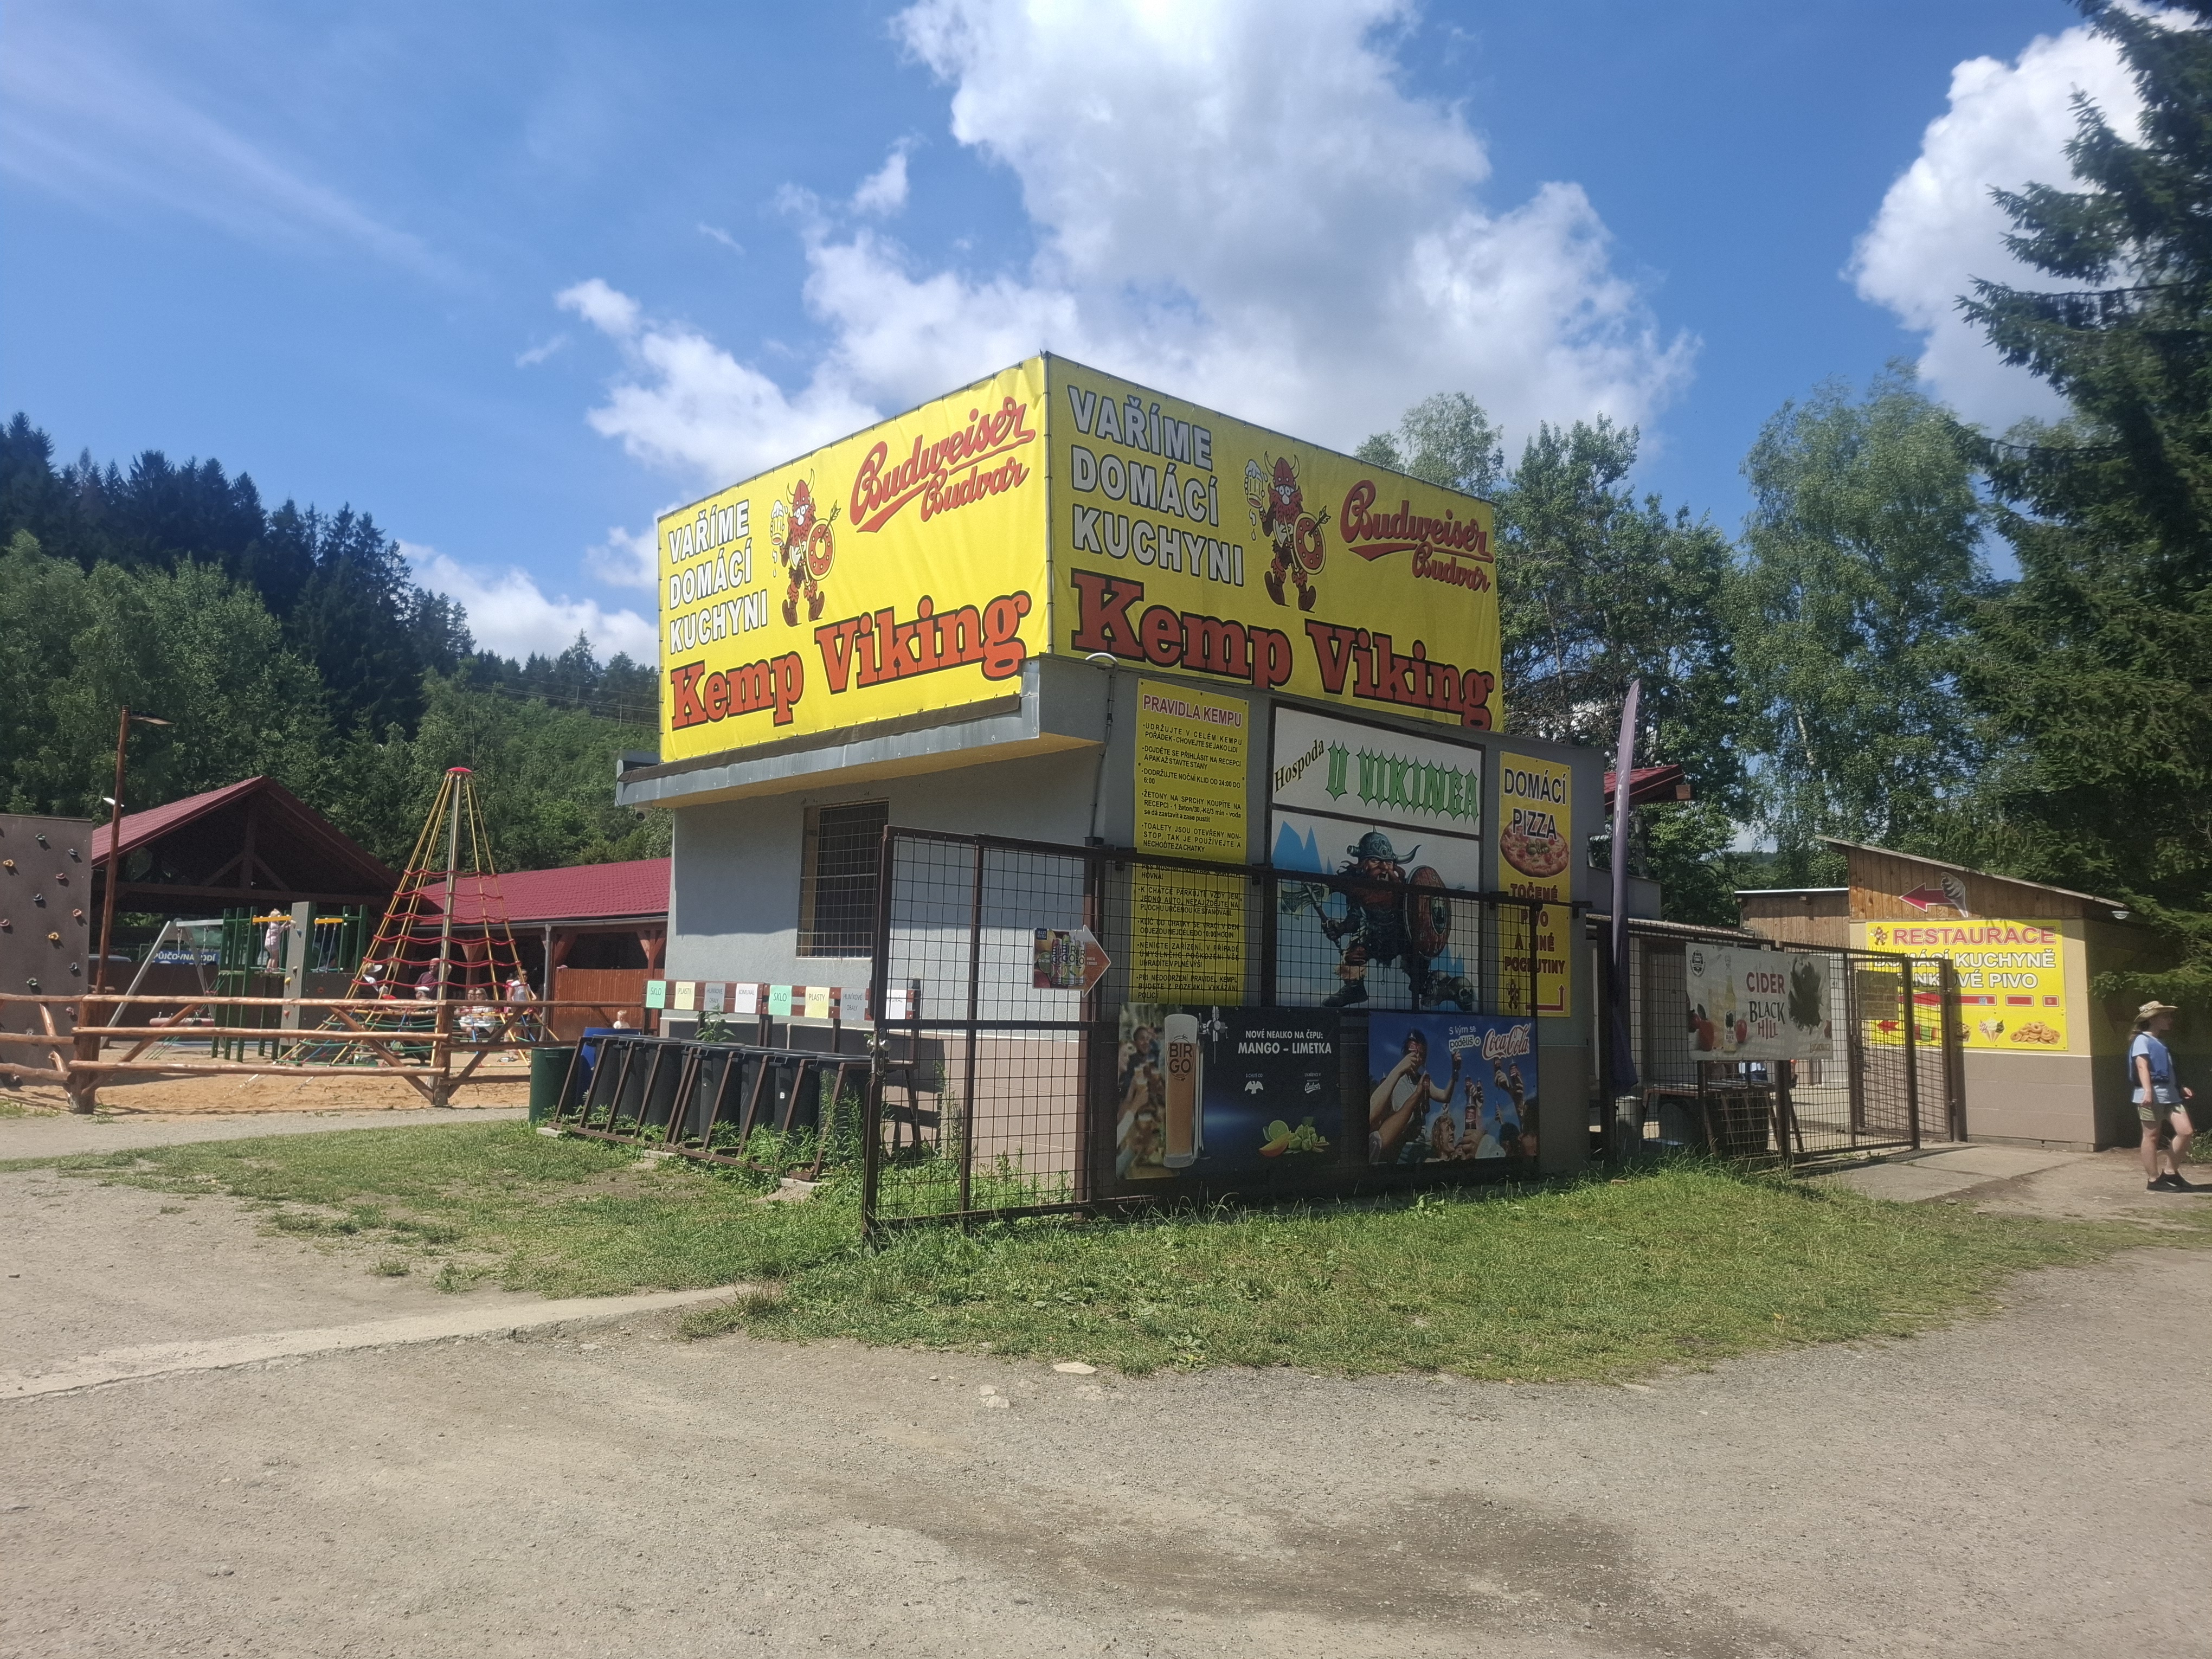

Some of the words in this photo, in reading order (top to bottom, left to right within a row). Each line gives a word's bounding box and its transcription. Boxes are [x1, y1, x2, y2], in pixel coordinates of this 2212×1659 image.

[1067, 385, 1212, 471] VAŘÍME
[850, 396, 1036, 526] Budweiser
[921, 456, 1030, 522] Budvar
[1071, 444, 1218, 526] DOMÁCÍ
[668, 499, 750, 564] VAŘÍME
[1340, 480, 1494, 564] Budweiser
[1072, 505, 1244, 587] KUCHYNI
[670, 538, 751, 609] DOMÁCÍ
[1412, 542, 1491, 593] Budvar
[670, 589, 768, 655] KUCHYNI
[1071, 568, 1293, 689] Kemp
[1306, 618, 1495, 730] Viking
[671, 651, 803, 730] Kemp
[815, 590, 1032, 695] Viking
[1143, 694, 1201, 720] PRAVIDLA
[1203, 706, 1242, 728] KEMPU
[1145, 731, 1173, 741] POŘÁDEK
[1176, 737, 1205, 747] CHOVEJTE
[1146, 722, 1182, 735] UDRŽUJTE
[1194, 731, 1216, 741] CELÉM
[1220, 737, 1242, 745] KEMPU
[1144, 745, 1171, 755] DOJDĚTE
[1181, 750, 1208, 762] PŘIHLÁSIT
[1218, 758, 1241, 767] RECEPCI
[1149, 755, 1160, 763] PAK
[1169, 758, 1189, 767] STAVTE
[1190, 761, 1208, 769] STANY
[1144, 768, 1178, 779] DODRŽUJTE
[1178, 773, 1195, 782] NOČNÍ
[1274, 738, 1324, 793] Hospoda
[1325, 738, 1350, 802] U
[1503, 768, 1566, 805] DOMÁCÍ
[1144, 789, 1167, 800] ŽETONY
[1181, 796, 1204, 805] SPRCHY
[1207, 800, 1231, 809] KOUPÍTE
[1144, 800, 1169, 809] RECEPCI
[1144, 822, 1172, 832] TOALETY
[1193, 828, 1224, 838] OTEVŘENY
[1512, 807, 1558, 841] PIZZA
[1143, 832, 1163, 840] STOP,
[1194, 836, 1234, 847] POUŽÍVEJTE
[1143, 840, 1174, 850] NECHOĎTE
[1183, 844, 1205, 853] CHATKY
[1176, 889, 1206, 897] PARKUJTE
[1510, 882, 1558, 902] TOČENÉ
[1165, 905, 1193, 914] URČENOU
[1168, 928, 1193, 936] NEJDÉLE
[1515, 933, 1523, 949] A
[1892, 926, 2057, 946] RESTAURACE
[1062, 945, 1076, 954] BIR
[1062, 953, 1076, 962] GO
[1954, 949, 2056, 968] KUCHYNĚ
[1152, 973, 1188, 981] NEDODRŽENÍ
[1746, 972, 1785, 994] CIDER
[1989, 973, 2038, 988] PIVO
[651, 987, 662, 995] SKLO
[773, 992, 787, 1002] SKLO
[808, 993, 826, 1002] PLASTY
[843, 993, 863, 1001] HLINÍKOVÉ
[1748, 1000, 1785, 1025] BLACK
[1246, 1028, 1264, 1038] NOVÉ
[1266, 1031, 1292, 1039] NEALKO
[1306, 1029, 1323, 1039] ČEPU:
[1455, 1025, 1468, 1036] kým
[1757, 1018, 1779, 1040] HILL
[1169, 1043, 1192, 1057] BIR
[1238, 1043, 1280, 1054] MANGO
[1293, 1043, 1332, 1054] LIMETKA
[1449, 1036, 1473, 1051] podělíš
[1475, 1038, 1481, 1046] o
[1482, 1023, 1531, 1060] Coca-Cola
[1169, 1058, 1191, 1073] GO
